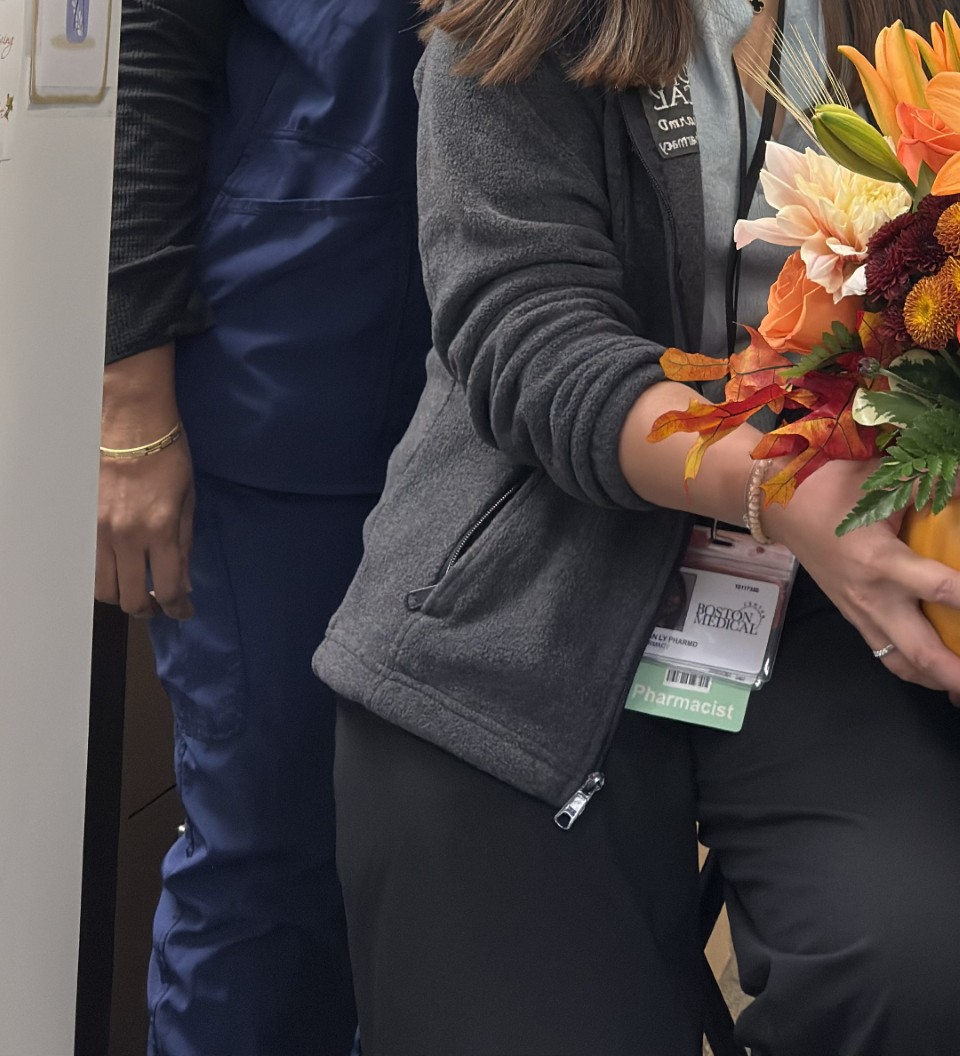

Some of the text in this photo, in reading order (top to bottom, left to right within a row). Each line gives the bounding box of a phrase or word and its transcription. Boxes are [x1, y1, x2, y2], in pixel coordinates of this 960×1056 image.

[693, 611, 758, 635] MEDICAL
[697, 602, 753, 624] BOSTON
[668, 636, 698, 648] PHARMD
[631, 684, 734, 720] Pharmacist
